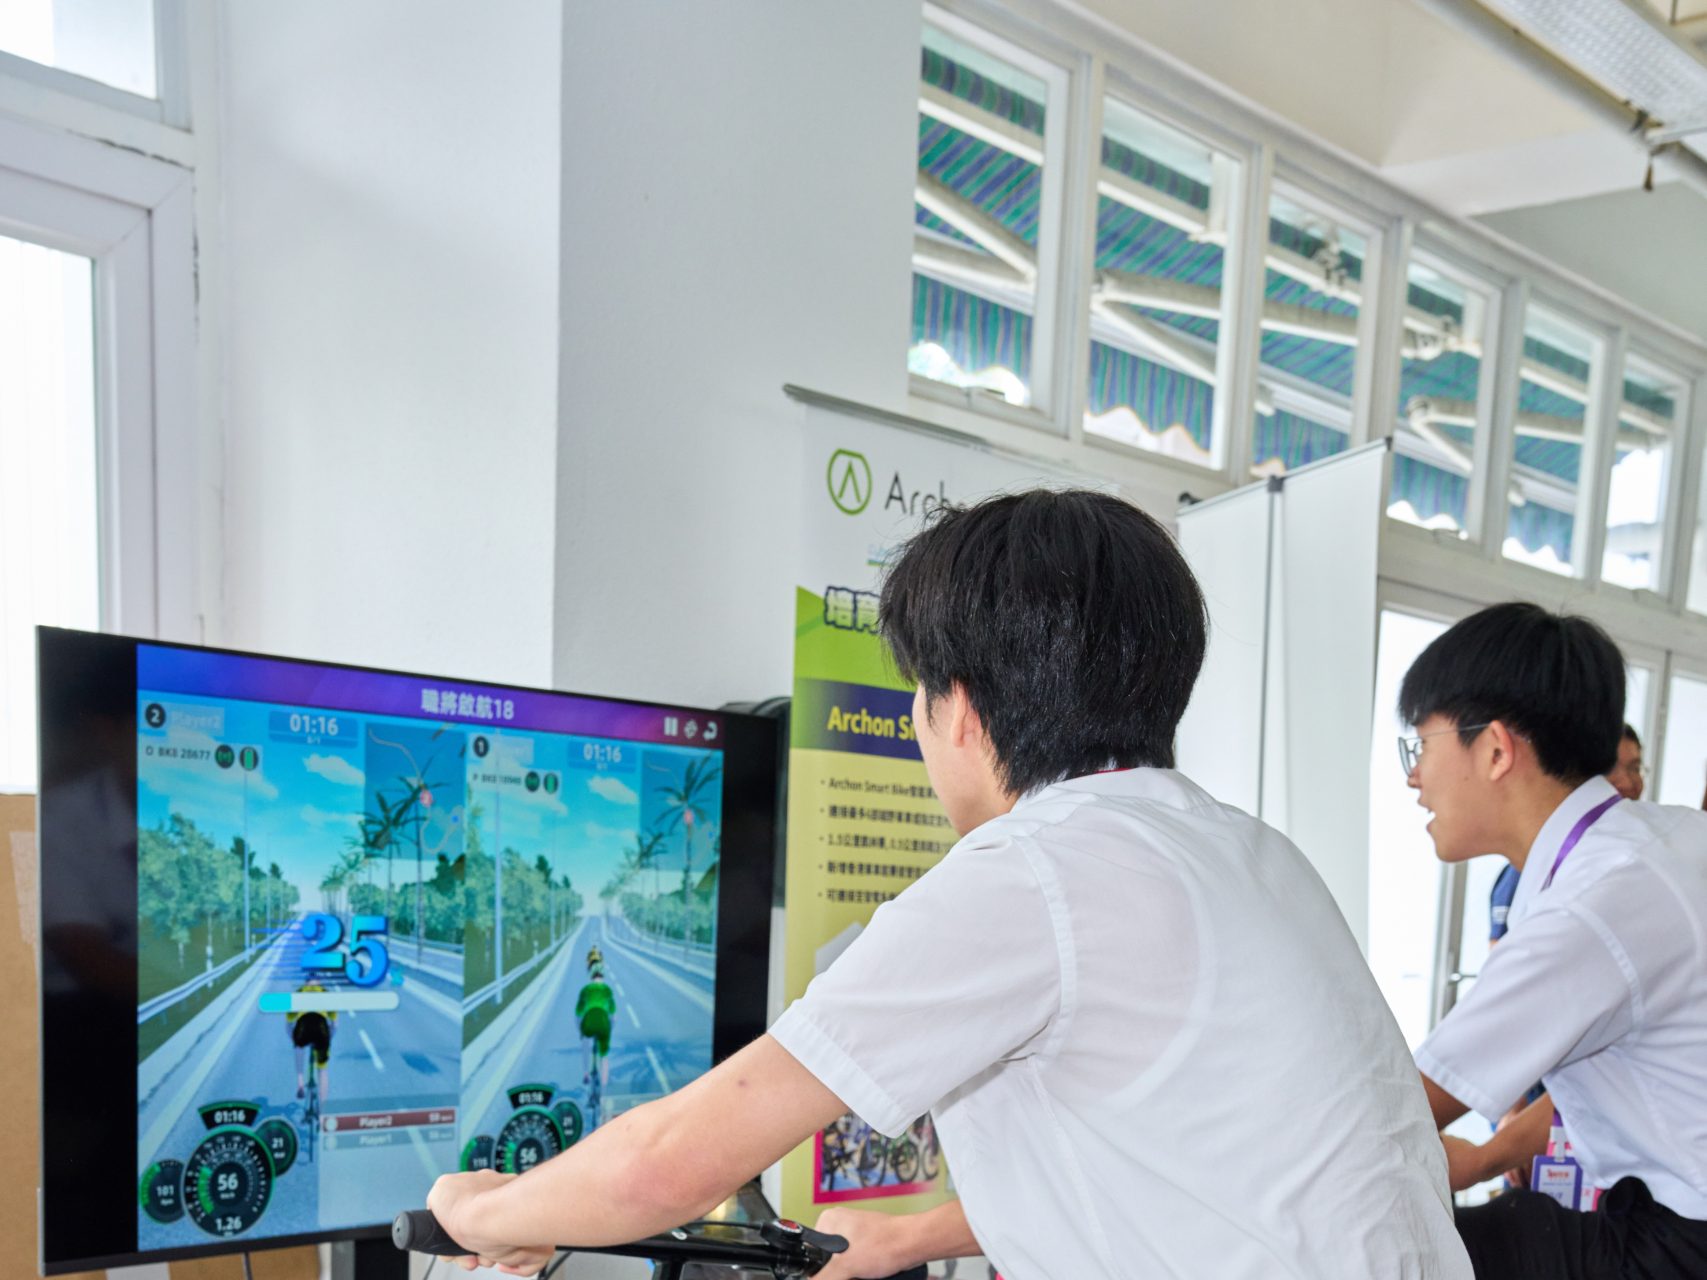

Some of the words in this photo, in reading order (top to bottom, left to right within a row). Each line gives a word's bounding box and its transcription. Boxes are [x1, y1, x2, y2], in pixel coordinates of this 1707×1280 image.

[884, 470, 968, 517] Arch
[289, 713, 339, 736] 01:16
[827, 706, 895, 738] Archon
[583, 743, 622, 763] 01:16
[301, 913, 389, 989] 25
[214, 1109, 247, 1124] 01:16
[520, 1147, 538, 1164] 56
[217, 1172, 240, 1192] 56
[215, 1216, 243, 1232] 1.26
